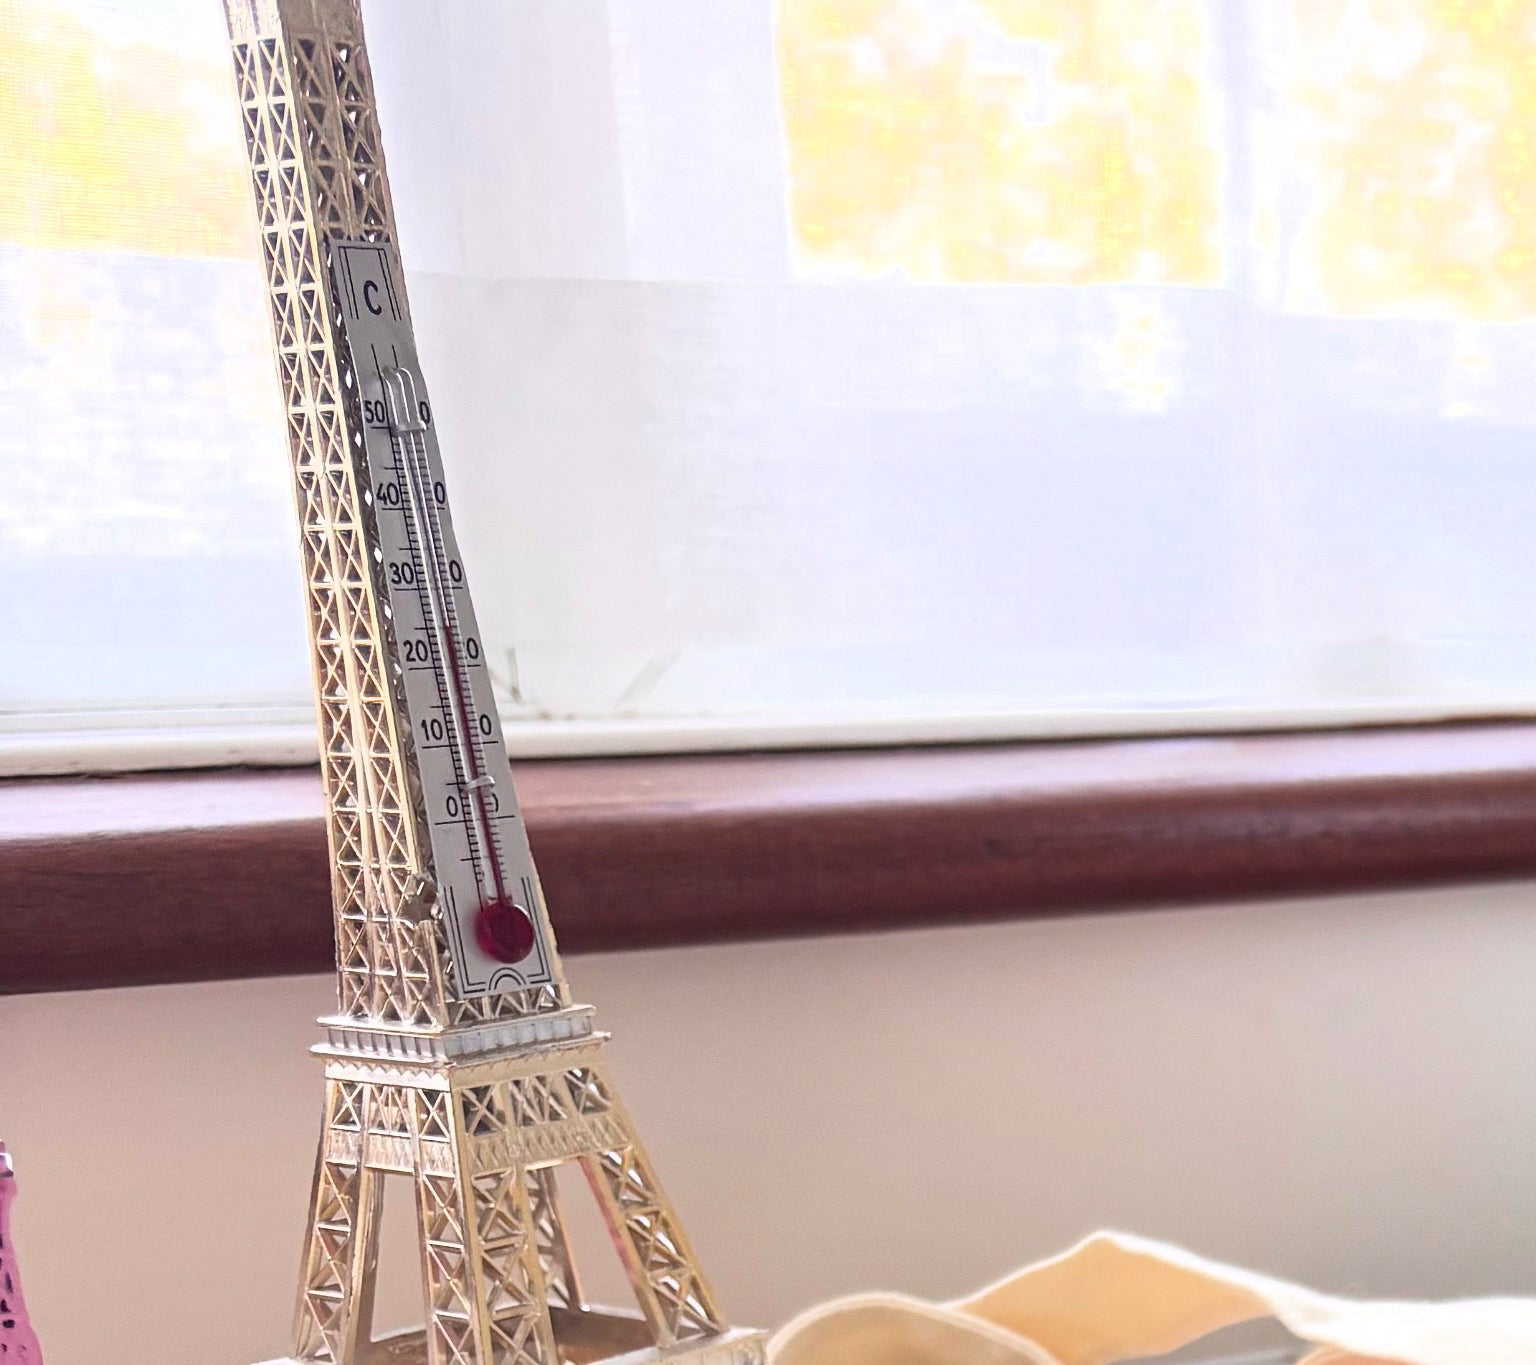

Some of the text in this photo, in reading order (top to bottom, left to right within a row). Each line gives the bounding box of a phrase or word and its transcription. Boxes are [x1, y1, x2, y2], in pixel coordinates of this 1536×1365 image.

[363, 280, 382, 315] C
[364, 400, 386, 423] 50
[376, 482, 400, 506] 40
[389, 562, 415, 585] 30
[403, 640, 429, 662] 20
[421, 718, 443, 741] 10
[446, 795, 458, 818] 0
